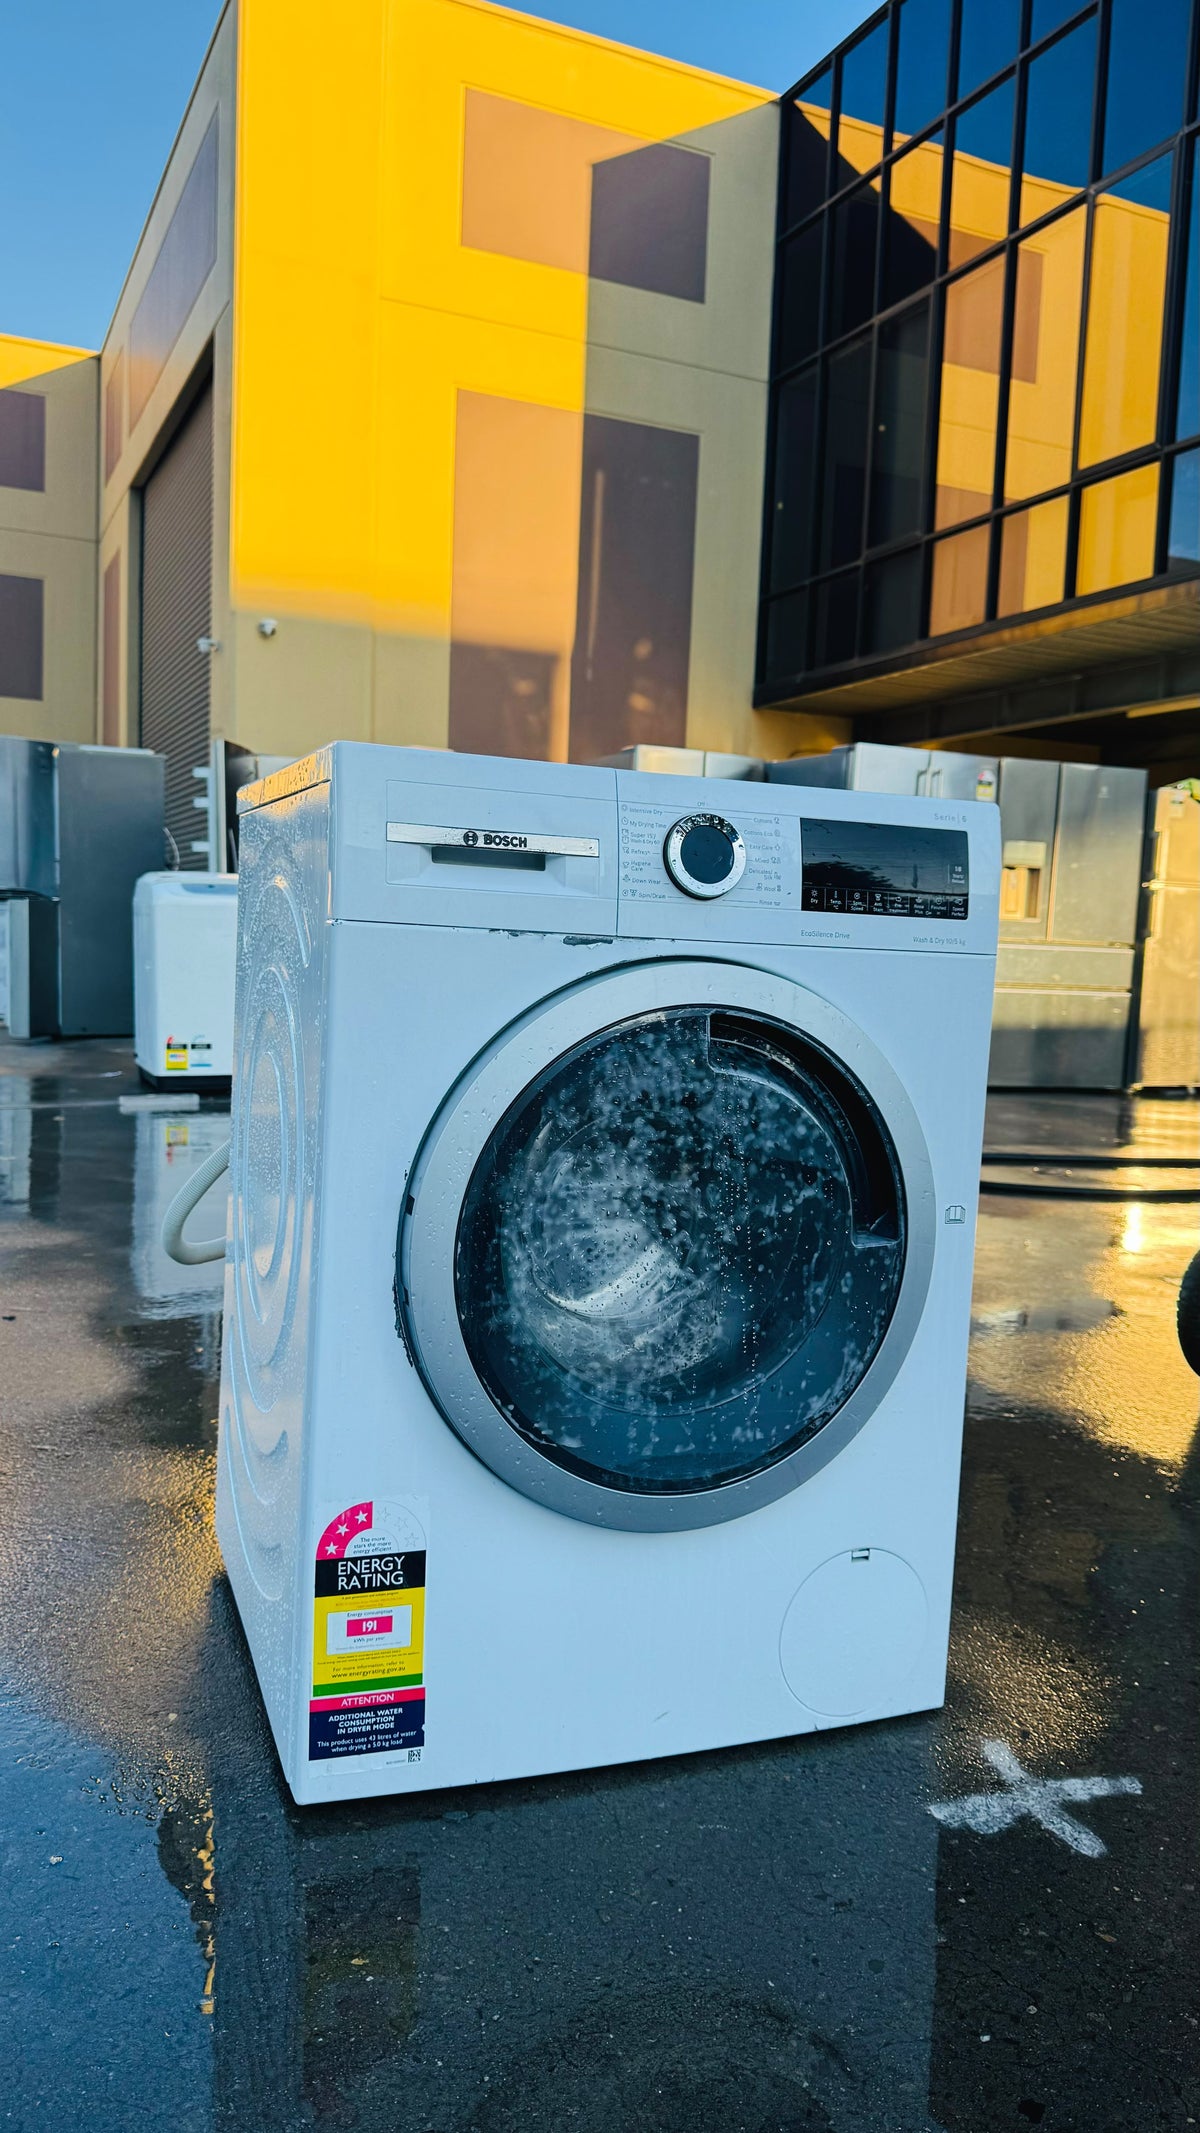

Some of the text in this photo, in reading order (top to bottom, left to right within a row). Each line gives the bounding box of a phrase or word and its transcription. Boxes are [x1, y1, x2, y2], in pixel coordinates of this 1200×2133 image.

[630, 807, 653, 815] Intensive
[934, 813, 956, 821] Serie
[484, 834, 527, 848] BOSCH
[801, 930, 833, 938] EcoSilence
[338, 1555, 405, 1575] ENERGY
[338, 1571, 403, 1590] RATING
[362, 1620, 377, 1632] 191
[332, 1666, 406, 1679] www.energyrating.gov.au
[341, 1693, 394, 1707] ATTENTION
[328, 1708, 403, 1722] ADDITIONAL WATER
[339, 1716, 394, 1728] CONSUMPTION
[347, 1724, 371, 1734] DRYER
[373, 1722, 394, 1731] MODE
[331, 1739, 353, 1748] product
[348, 1743, 366, 1752] drying
